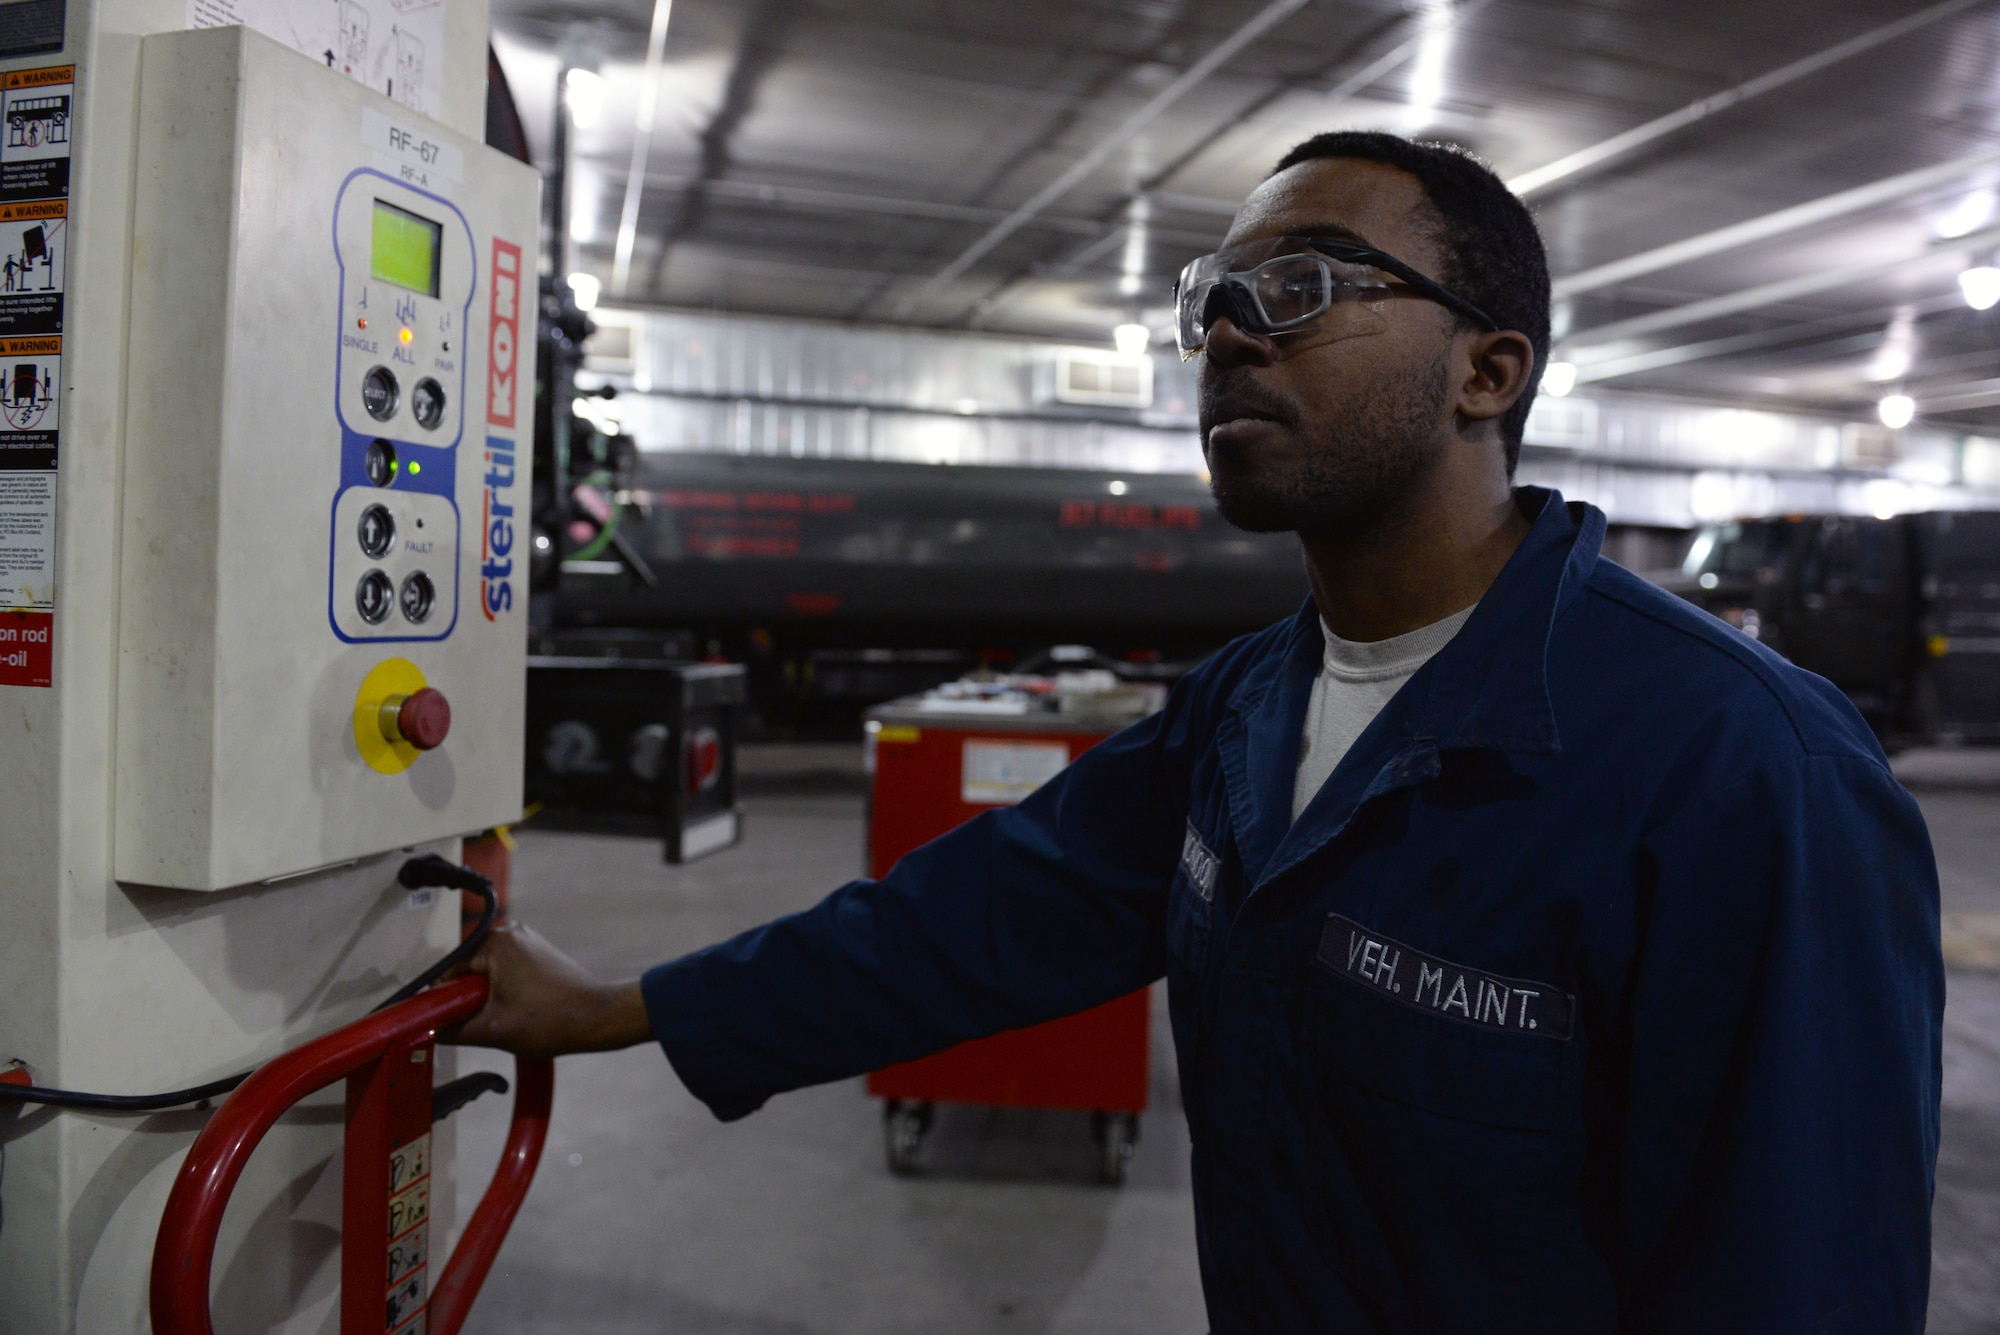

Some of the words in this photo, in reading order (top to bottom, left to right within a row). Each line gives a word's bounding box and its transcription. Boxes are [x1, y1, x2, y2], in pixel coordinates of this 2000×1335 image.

[24, 70, 70, 84] WARNING
[389, 126, 440, 165] RF-67
[400, 164, 428, 187] RF-A
[16, 204, 64, 217] WARNING
[490, 240, 520, 426] KONI
[10, 340, 58, 352] WARNING
[342, 334, 379, 354] SINGLE
[392, 346, 416, 365] ALL
[481, 433, 517, 616] stertil
[404, 540, 433, 554] FAULT
[22, 626, 48, 642] rod
[0, 650, 27, 666] -oil
[1346, 930, 1401, 994] VEH.
[1414, 961, 1540, 1030] MAINT.
